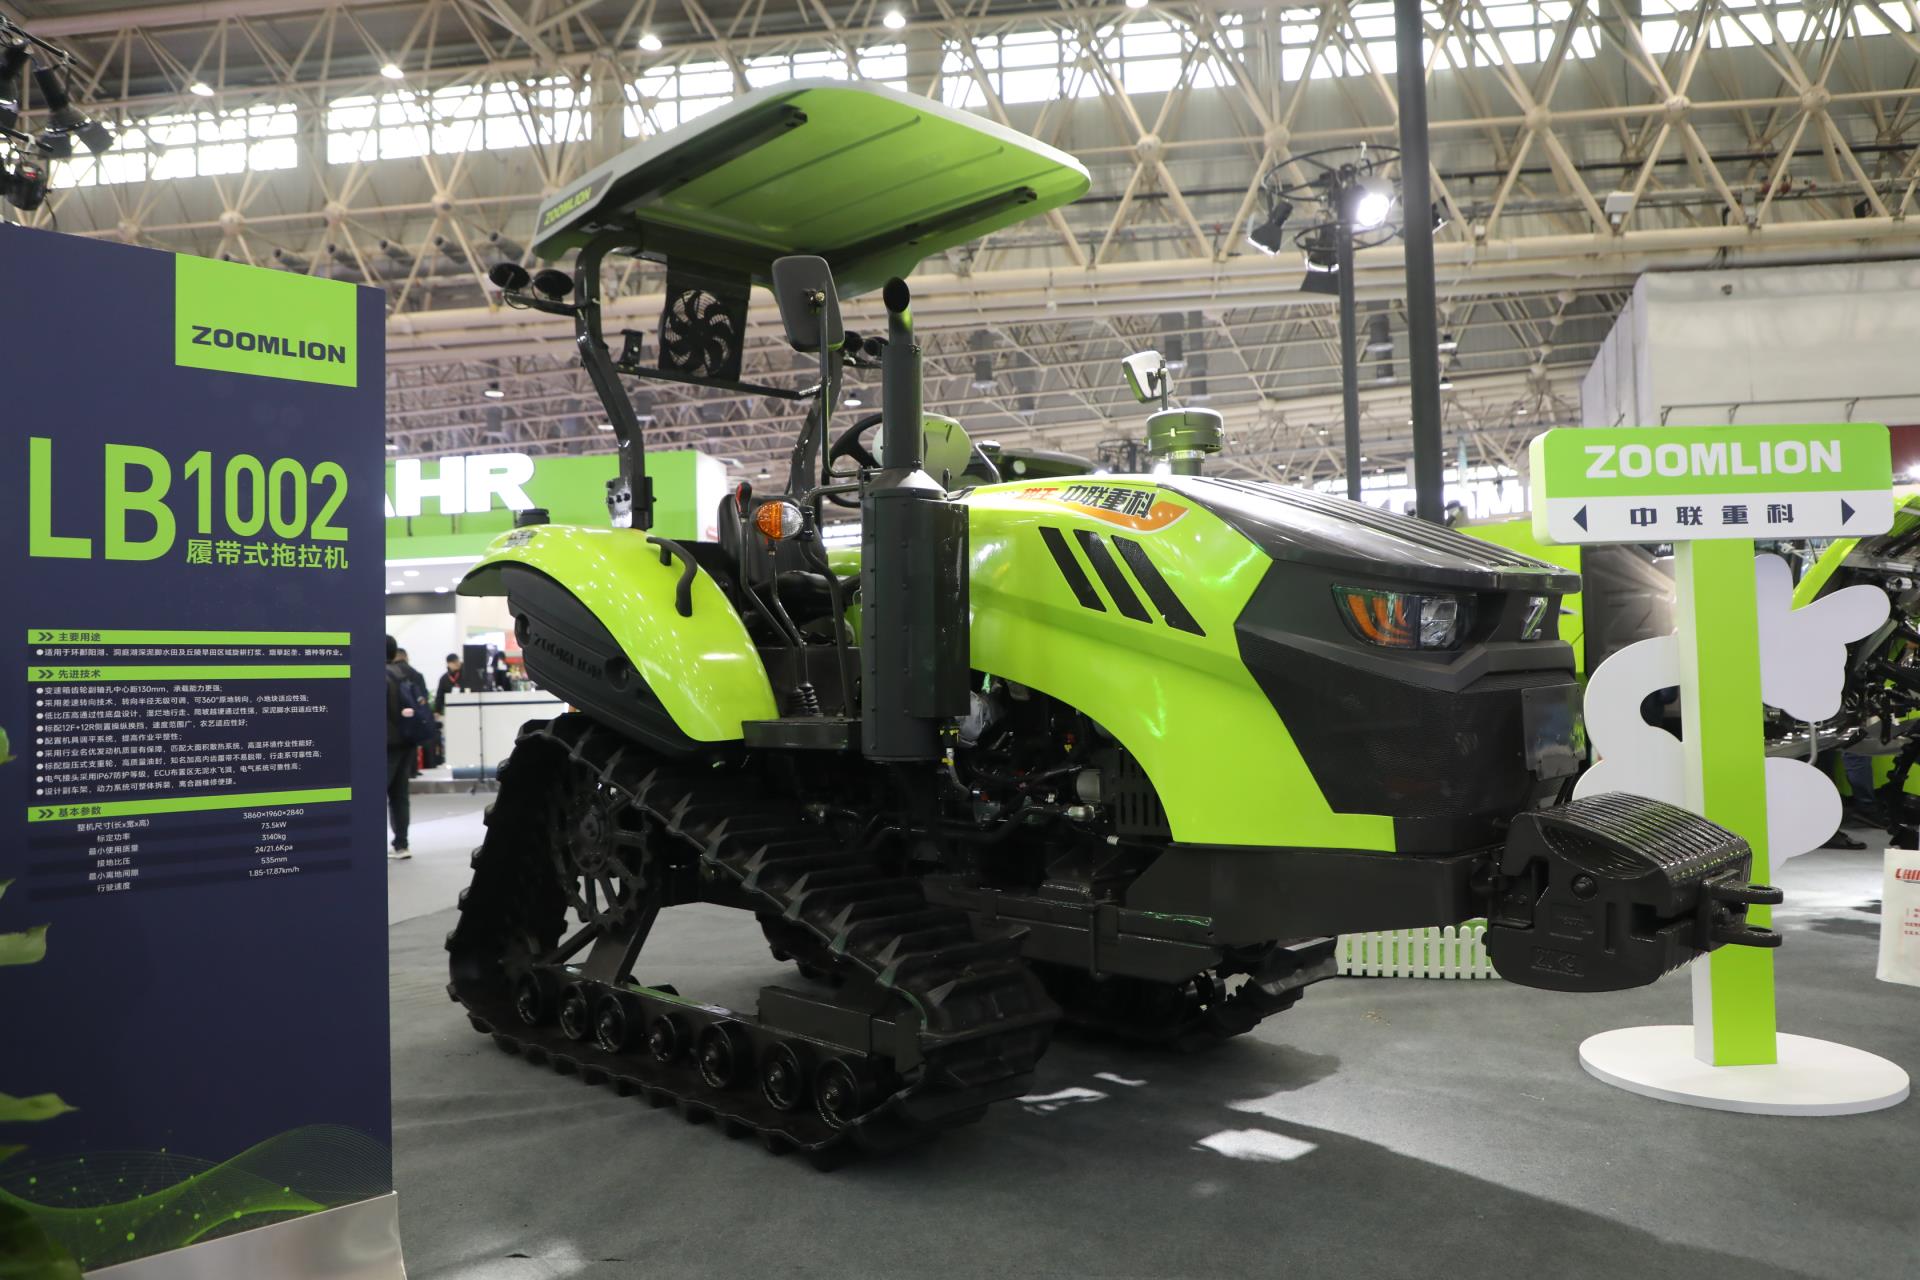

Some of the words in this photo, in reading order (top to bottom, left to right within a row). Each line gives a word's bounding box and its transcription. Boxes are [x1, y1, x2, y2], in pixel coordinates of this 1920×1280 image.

[191, 324, 346, 364] ZOOMLION
[1584, 439, 1842, 479] ZOOMLION
[385, 452, 536, 518] HR
[1059, 484, 1157, 520] 中联重科
[1629, 503, 1794, 527] 中联重科
[186, 538, 349, 570] 履带式拖拉机
[58, 632, 102, 642] 主要用途
[58, 669, 102, 680] 先进技术
[58, 806, 102, 818] 基本参数
[97, 832, 131, 843] 标定功率
[97, 857, 131, 868] 接地比压
[261, 856, 288, 865] 535mm
[97, 881, 131, 893] 行驶速度
